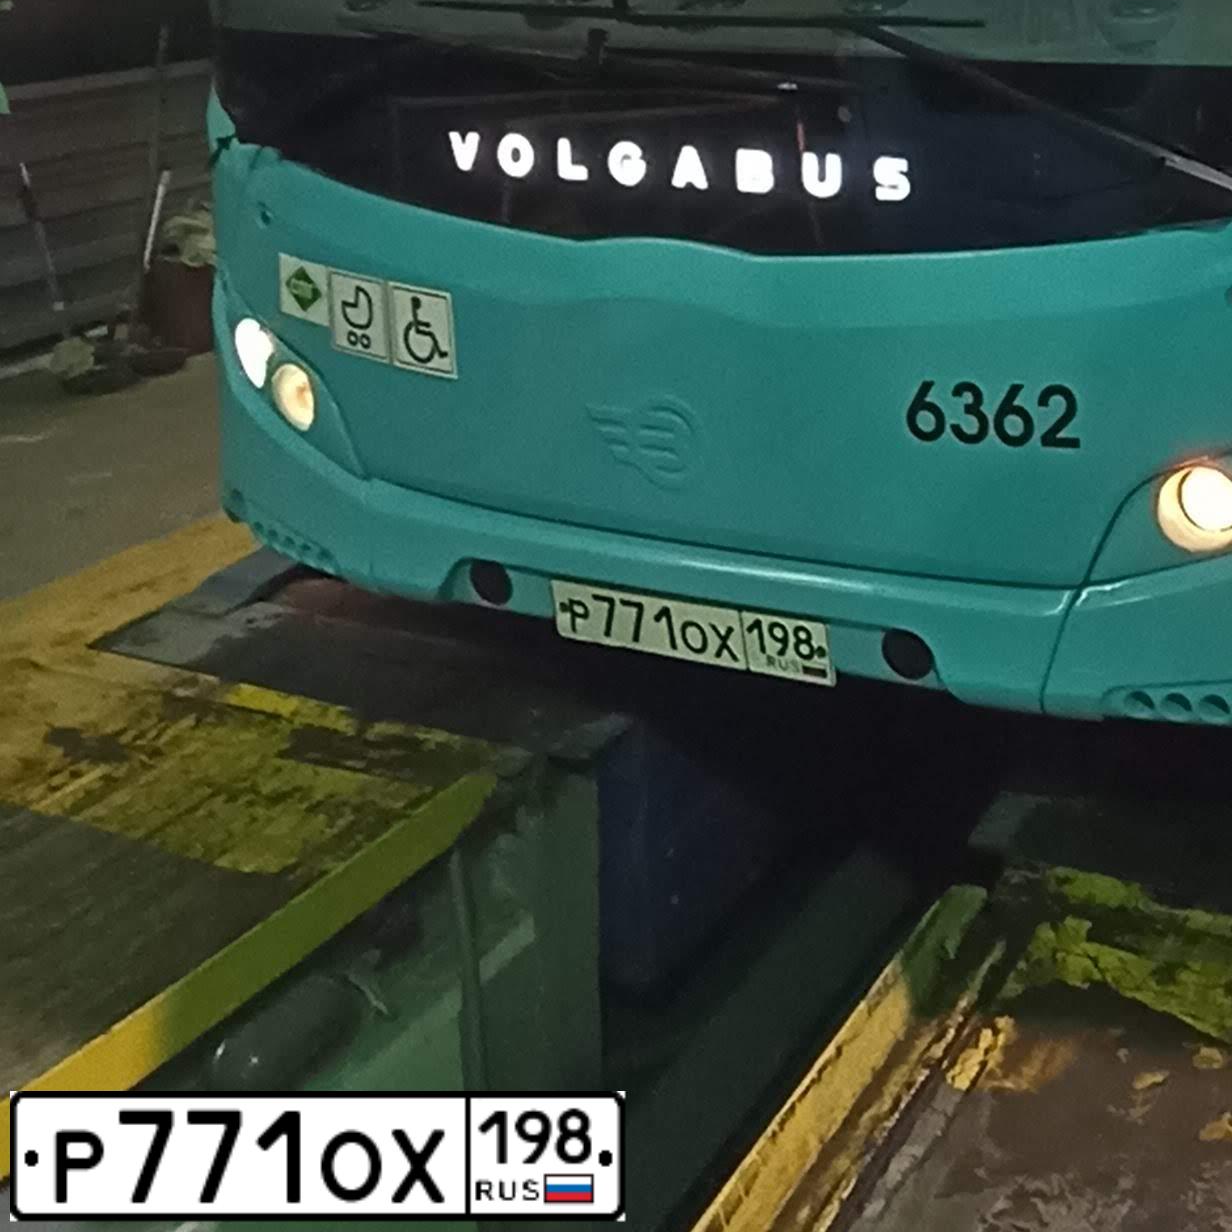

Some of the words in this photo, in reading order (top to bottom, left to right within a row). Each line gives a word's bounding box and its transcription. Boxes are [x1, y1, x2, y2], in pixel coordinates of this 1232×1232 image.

[449, 131, 911, 201] VOLGABUS
[906, 380, 1081, 449] 6362
[747, 618, 815, 660] 198
